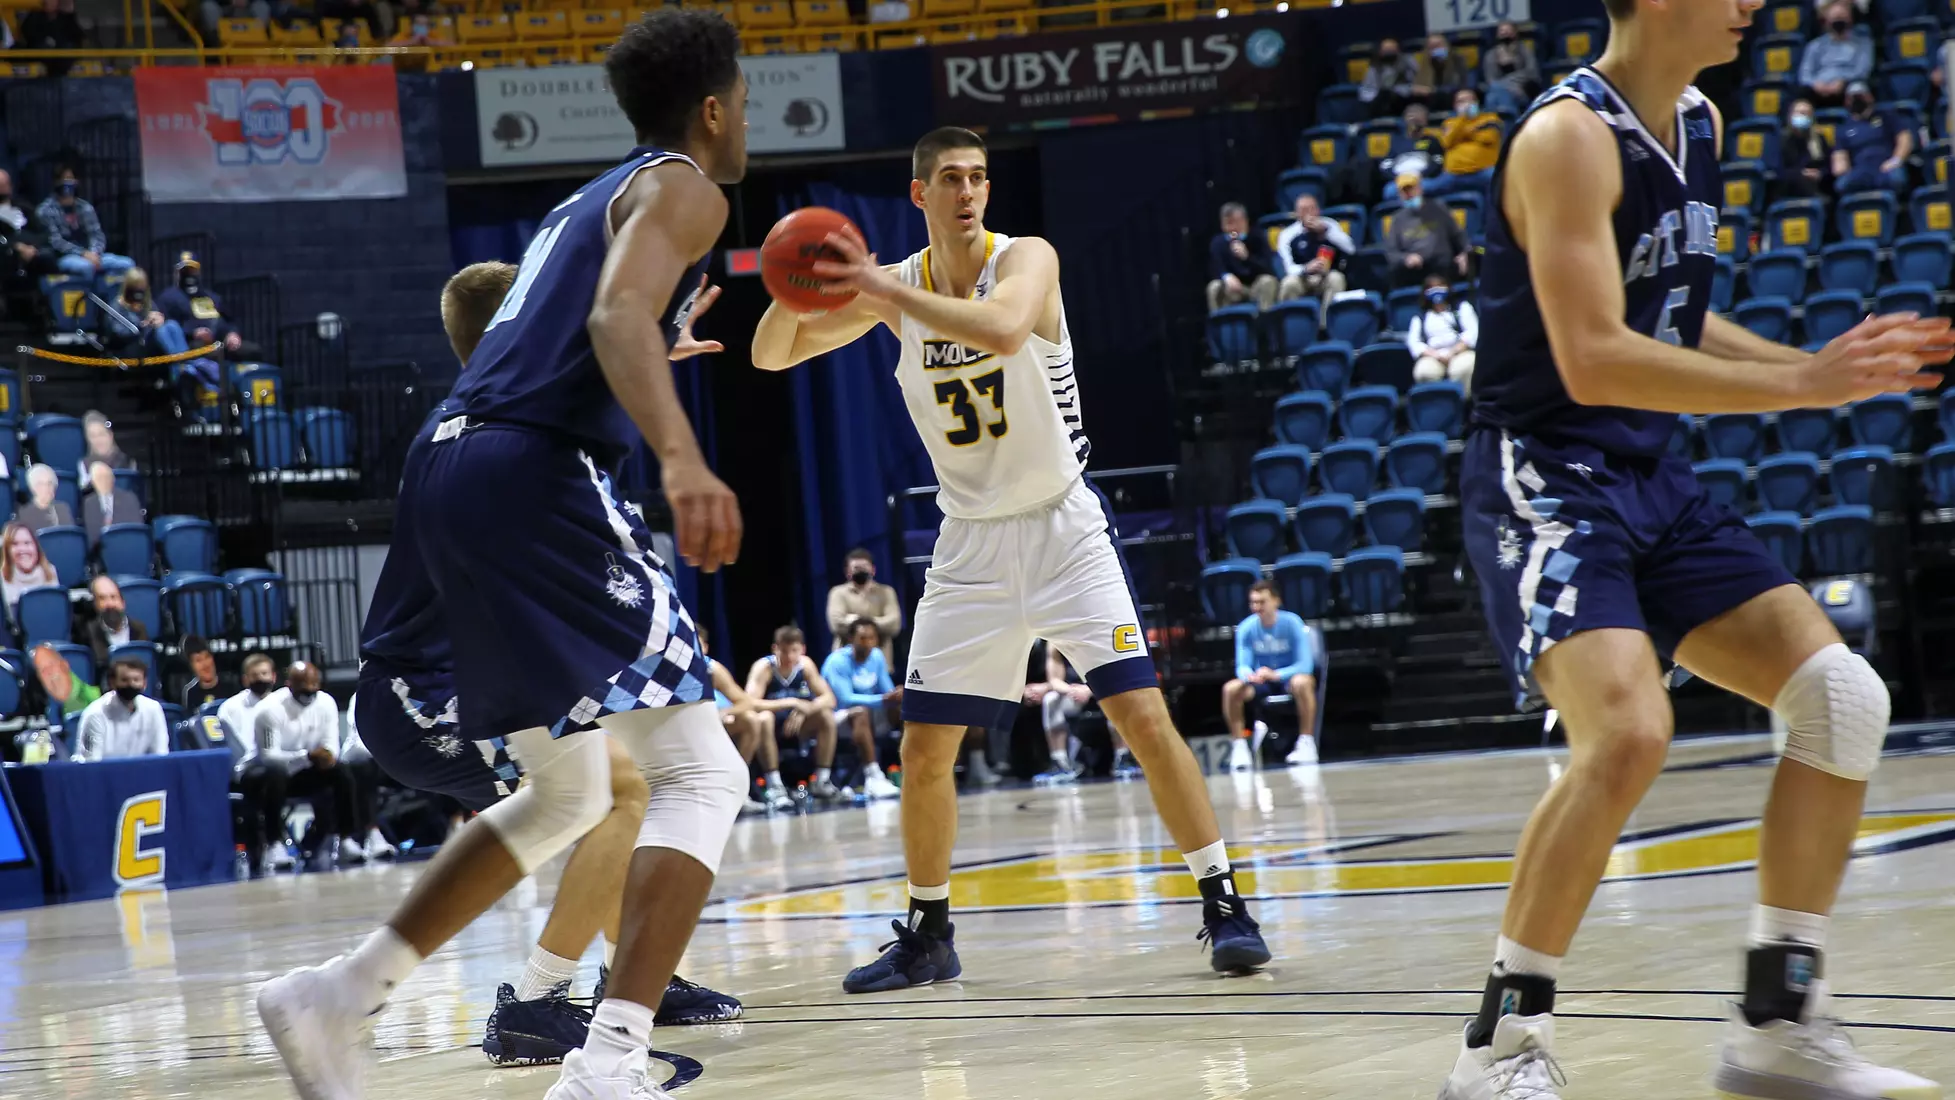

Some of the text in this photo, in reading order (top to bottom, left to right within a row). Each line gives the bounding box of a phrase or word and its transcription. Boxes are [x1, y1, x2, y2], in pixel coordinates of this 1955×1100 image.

[1446, 0, 1510, 25] 120
[944, 34, 1239, 102] RUBY FALLS
[500, 78, 610, 98] DOUBLE
[1020, 75, 1218, 107] naturally wonderful
[932, 365, 1009, 447] 33
[1112, 624, 1138, 653] C
[112, 790, 167, 886] C
